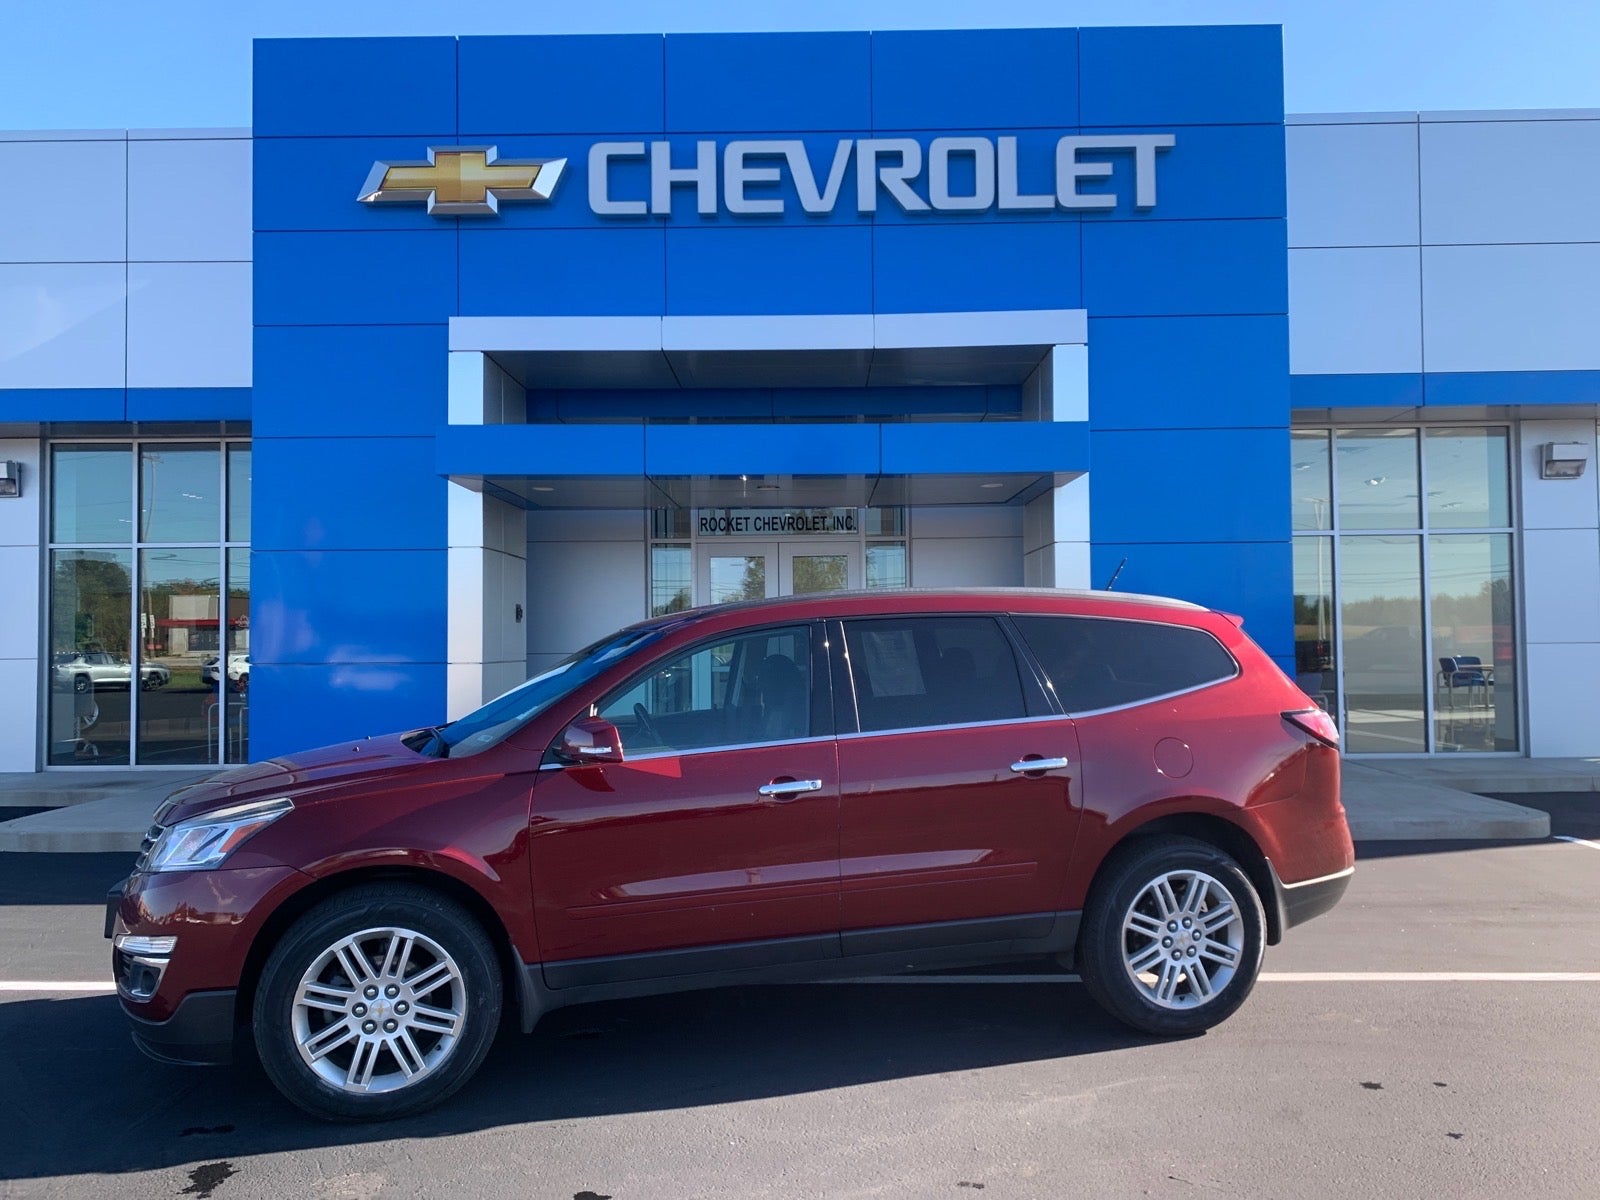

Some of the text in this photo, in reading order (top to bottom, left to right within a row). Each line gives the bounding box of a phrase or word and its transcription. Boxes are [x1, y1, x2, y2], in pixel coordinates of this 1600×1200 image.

[587, 133, 1176, 216] CHEVROLET
[700, 516, 751, 532] ROCKET
[833, 515, 857, 531] INC.
